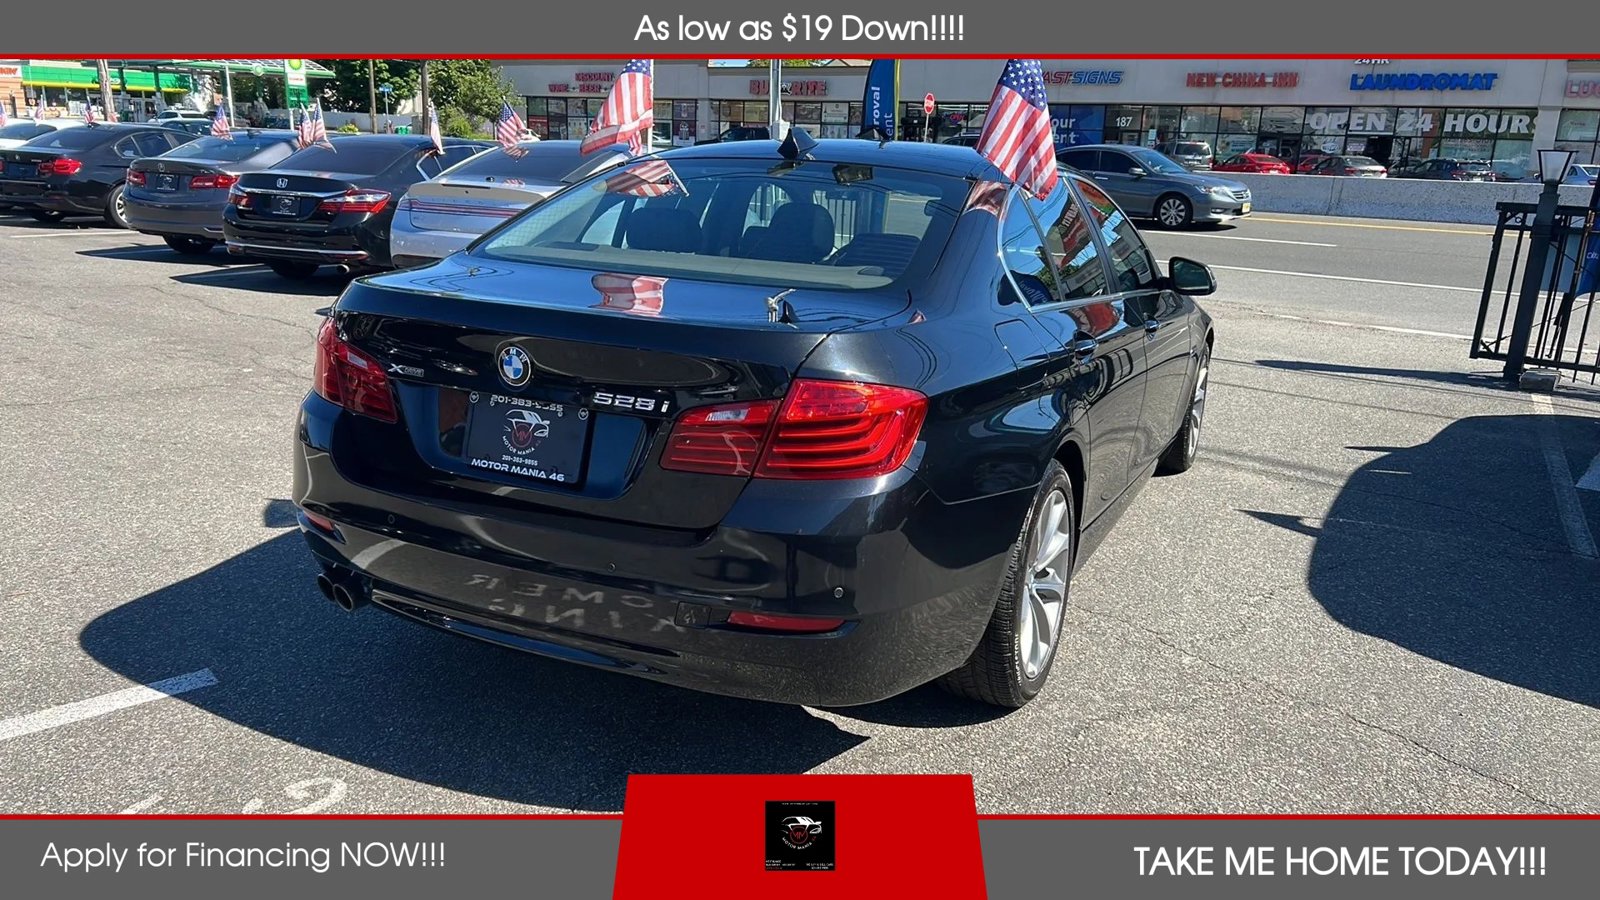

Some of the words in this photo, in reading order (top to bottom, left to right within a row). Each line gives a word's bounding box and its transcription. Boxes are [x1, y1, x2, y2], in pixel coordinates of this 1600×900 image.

[1041, 71, 1124, 84] ASTSIGNS
[1186, 72, 1217, 88] NEW
[1221, 72, 1266, 88] CHINA
[1272, 72, 1300, 88] INN
[1350, 73, 1498, 91] LAUNDROMAT
[749, 80, 770, 96] BU
[871, 86, 881, 127] roval
[884, 113, 894, 138] ent
[1050, 115, 1077, 129] our
[1116, 116, 1133, 128] 187
[1309, 112, 1387, 132] OPEN
[1396, 113, 1434, 132] 24
[1053, 130, 1077, 144] ent
[501, 348, 527, 363] BMW
[471, 458, 509, 472] MOTOR
[510, 465, 547, 479] MANIA
[549, 473, 565, 482] 46
